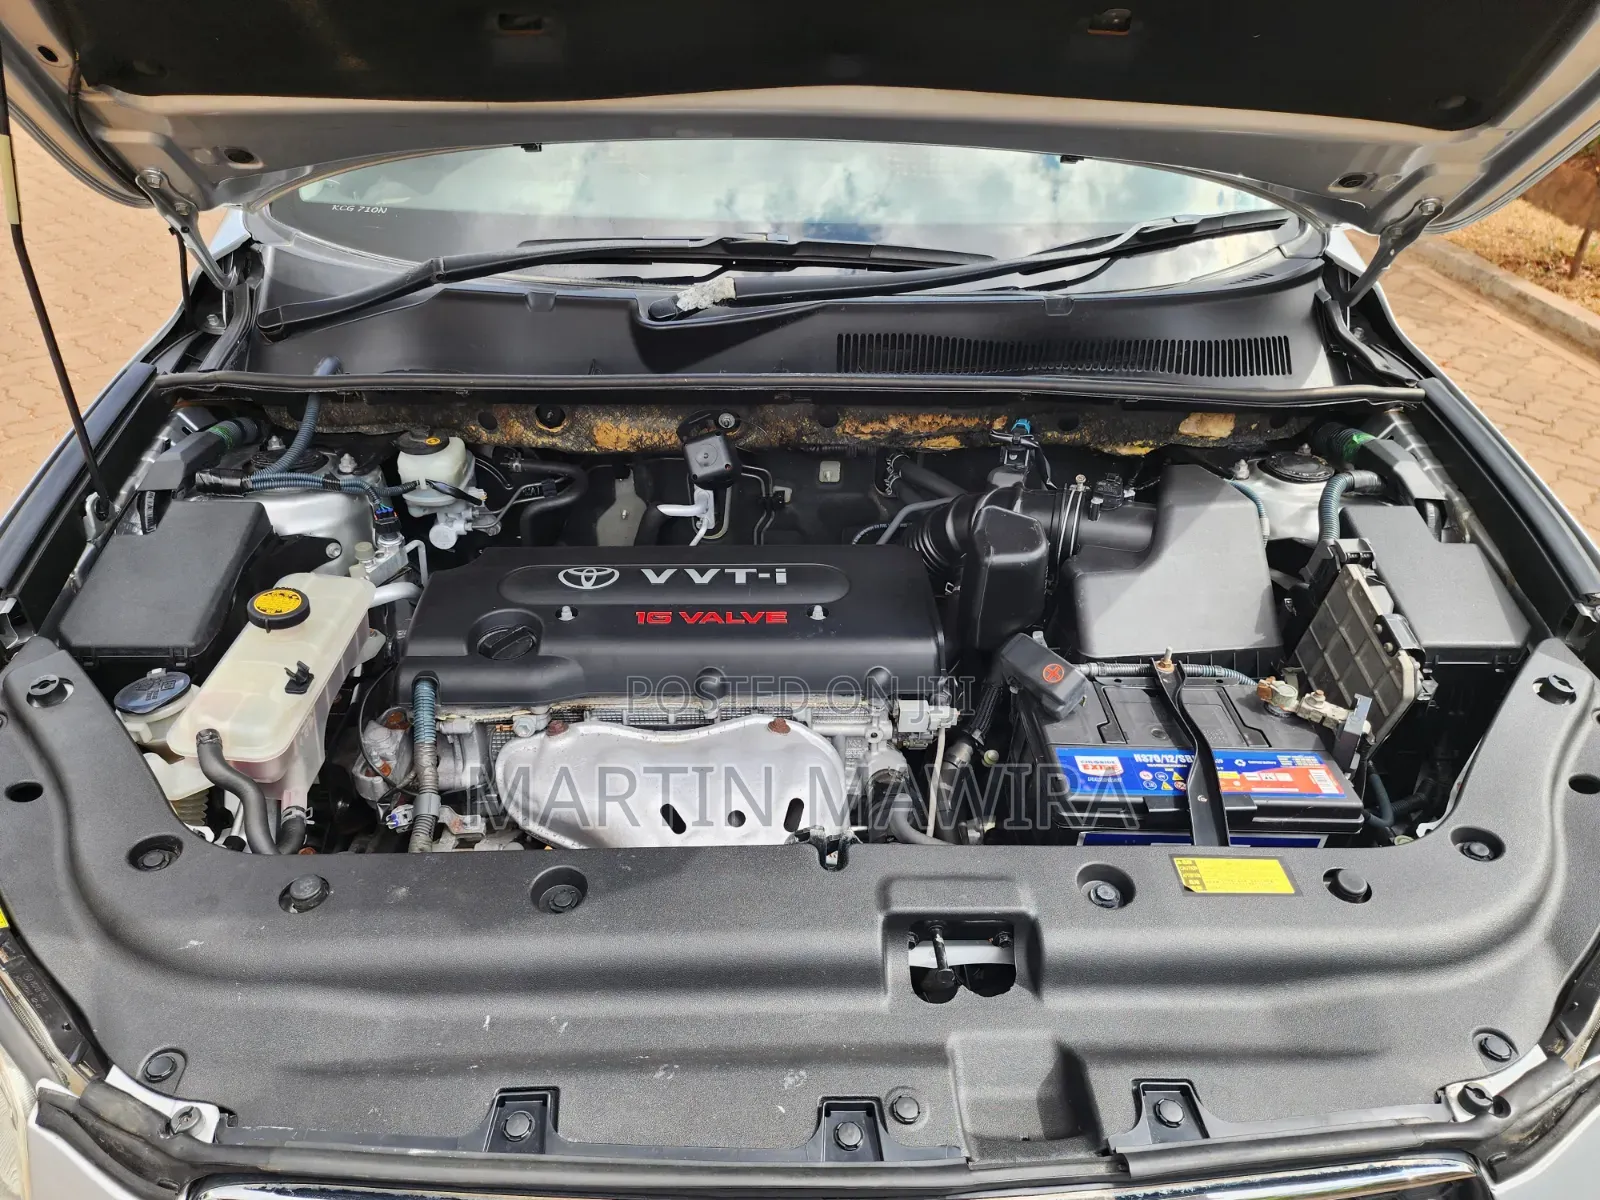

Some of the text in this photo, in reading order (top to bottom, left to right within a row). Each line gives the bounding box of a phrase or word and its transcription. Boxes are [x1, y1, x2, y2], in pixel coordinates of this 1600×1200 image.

[331, 204, 388, 214] KCG 710N
[640, 568, 787, 585] VVT-i
[635, 611, 788, 625] 16 VALVE
[1081, 763, 1120, 771] EXIDE
